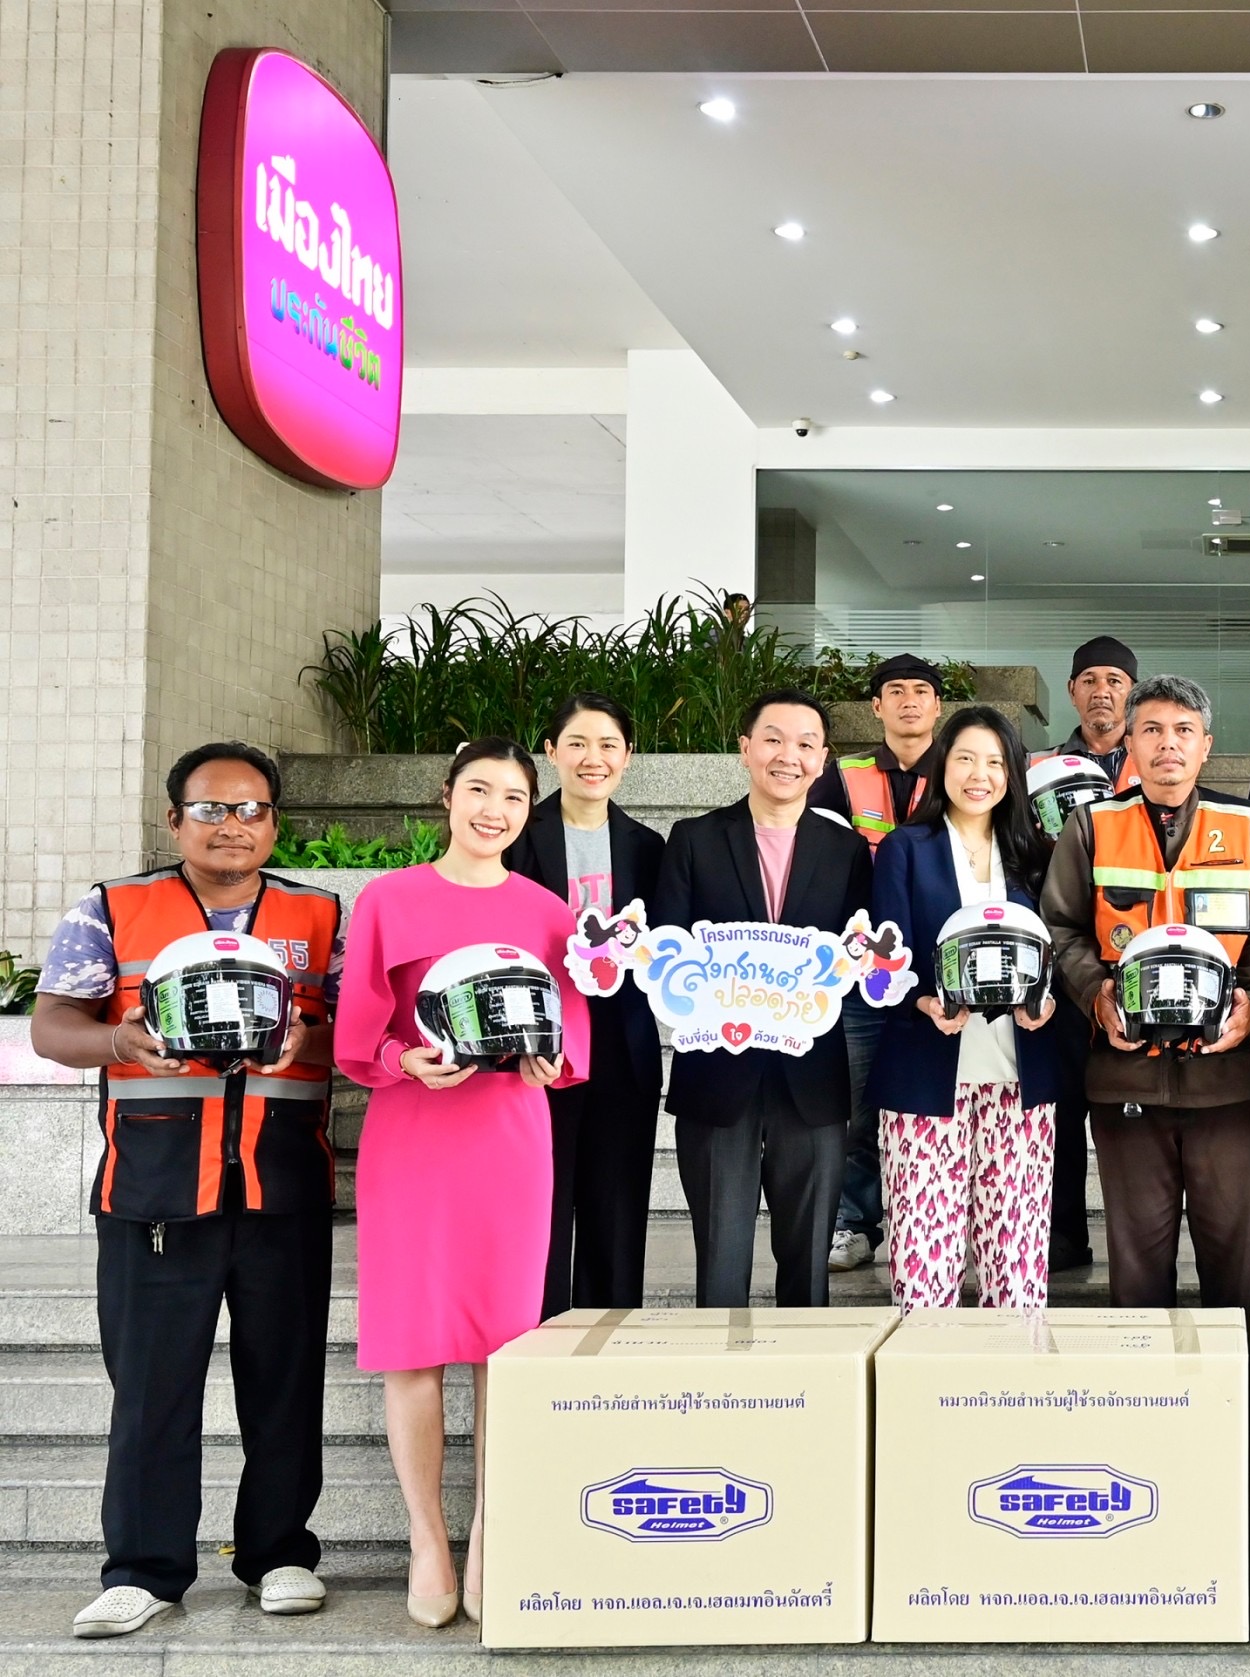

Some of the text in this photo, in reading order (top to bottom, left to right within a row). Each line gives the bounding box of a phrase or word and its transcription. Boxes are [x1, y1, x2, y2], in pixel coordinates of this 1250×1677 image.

[255, 155, 394, 330] เมืองไทย
[271, 277, 380, 391] ประกันชีวิต
[1208, 829, 1225, 853] 2
[700, 927, 813, 949] โครงการรณรงค์
[268, 938, 309, 970] 55
[661, 945, 812, 1011] สงกรานต์
[714, 977, 829, 1024] ปลอดภัย
[754, 1030, 778, 1044] ด้วย
[551, 1390, 805, 1415] หมวกนิรภัยสำหรับผู้ใช้รถจักรยานยนต์
[939, 1388, 1190, 1412] หมวกนิรภัยสำหรับผู้ใช้รถจักรยานยนต์
[649, 1520, 705, 1531] Helmet
[1036, 1517, 1091, 1527] Helmet
[519, 1591, 582, 1612] ผลิตโดย
[908, 1586, 970, 1606] ผลิตโดย
